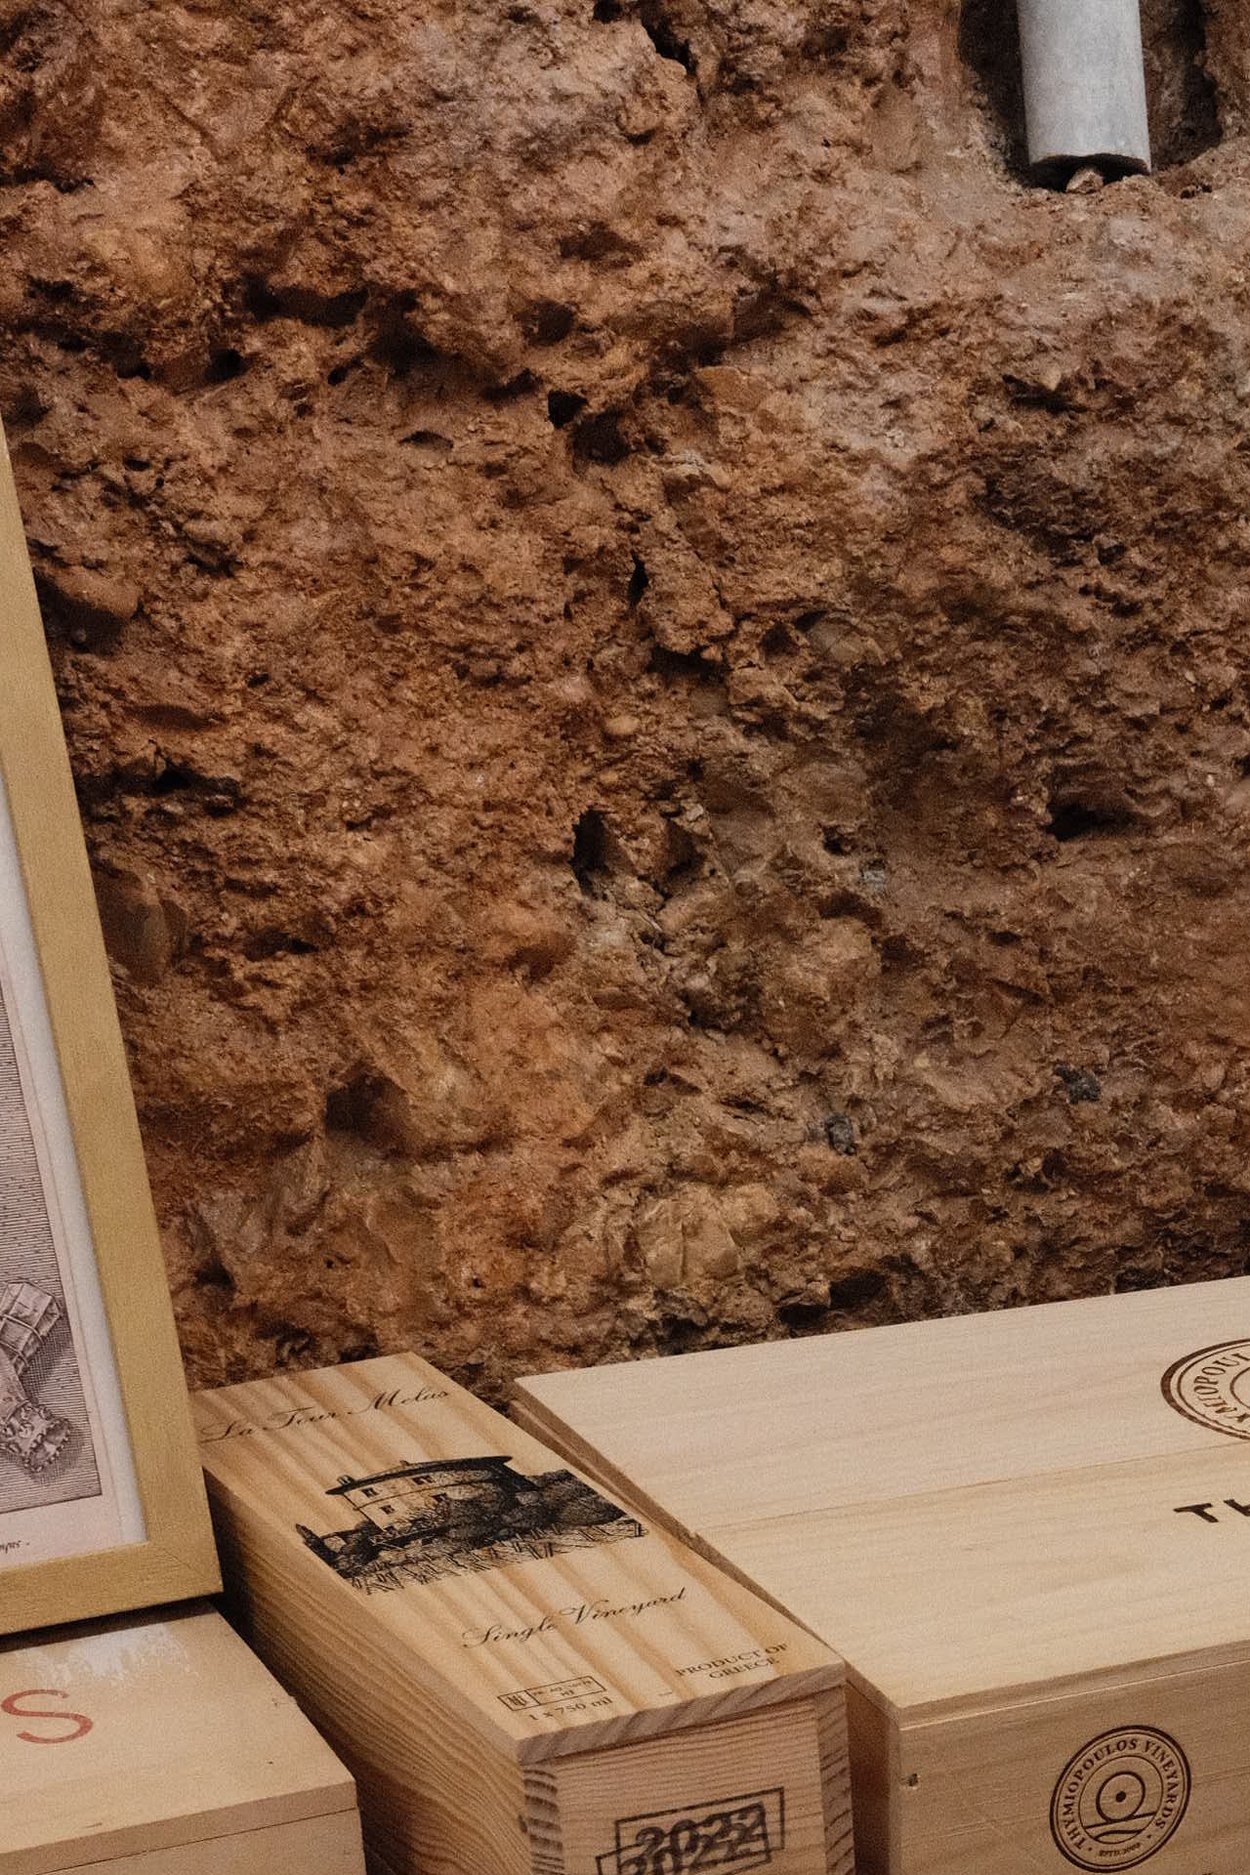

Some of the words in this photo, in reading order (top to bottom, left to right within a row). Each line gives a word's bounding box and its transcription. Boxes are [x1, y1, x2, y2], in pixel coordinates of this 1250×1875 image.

[462, 1616, 558, 1648] Single
[559, 1587, 686, 1625] Vineyard
[675, 1649, 761, 1676] PRODUCT
[765, 1643, 788, 1654] OF
[709, 1657, 780, 1679] GREECE
[1063, 1738, 1139, 1851] THYMIOPOULOS
[1144, 1738, 1180, 1831] VINEYARDS
